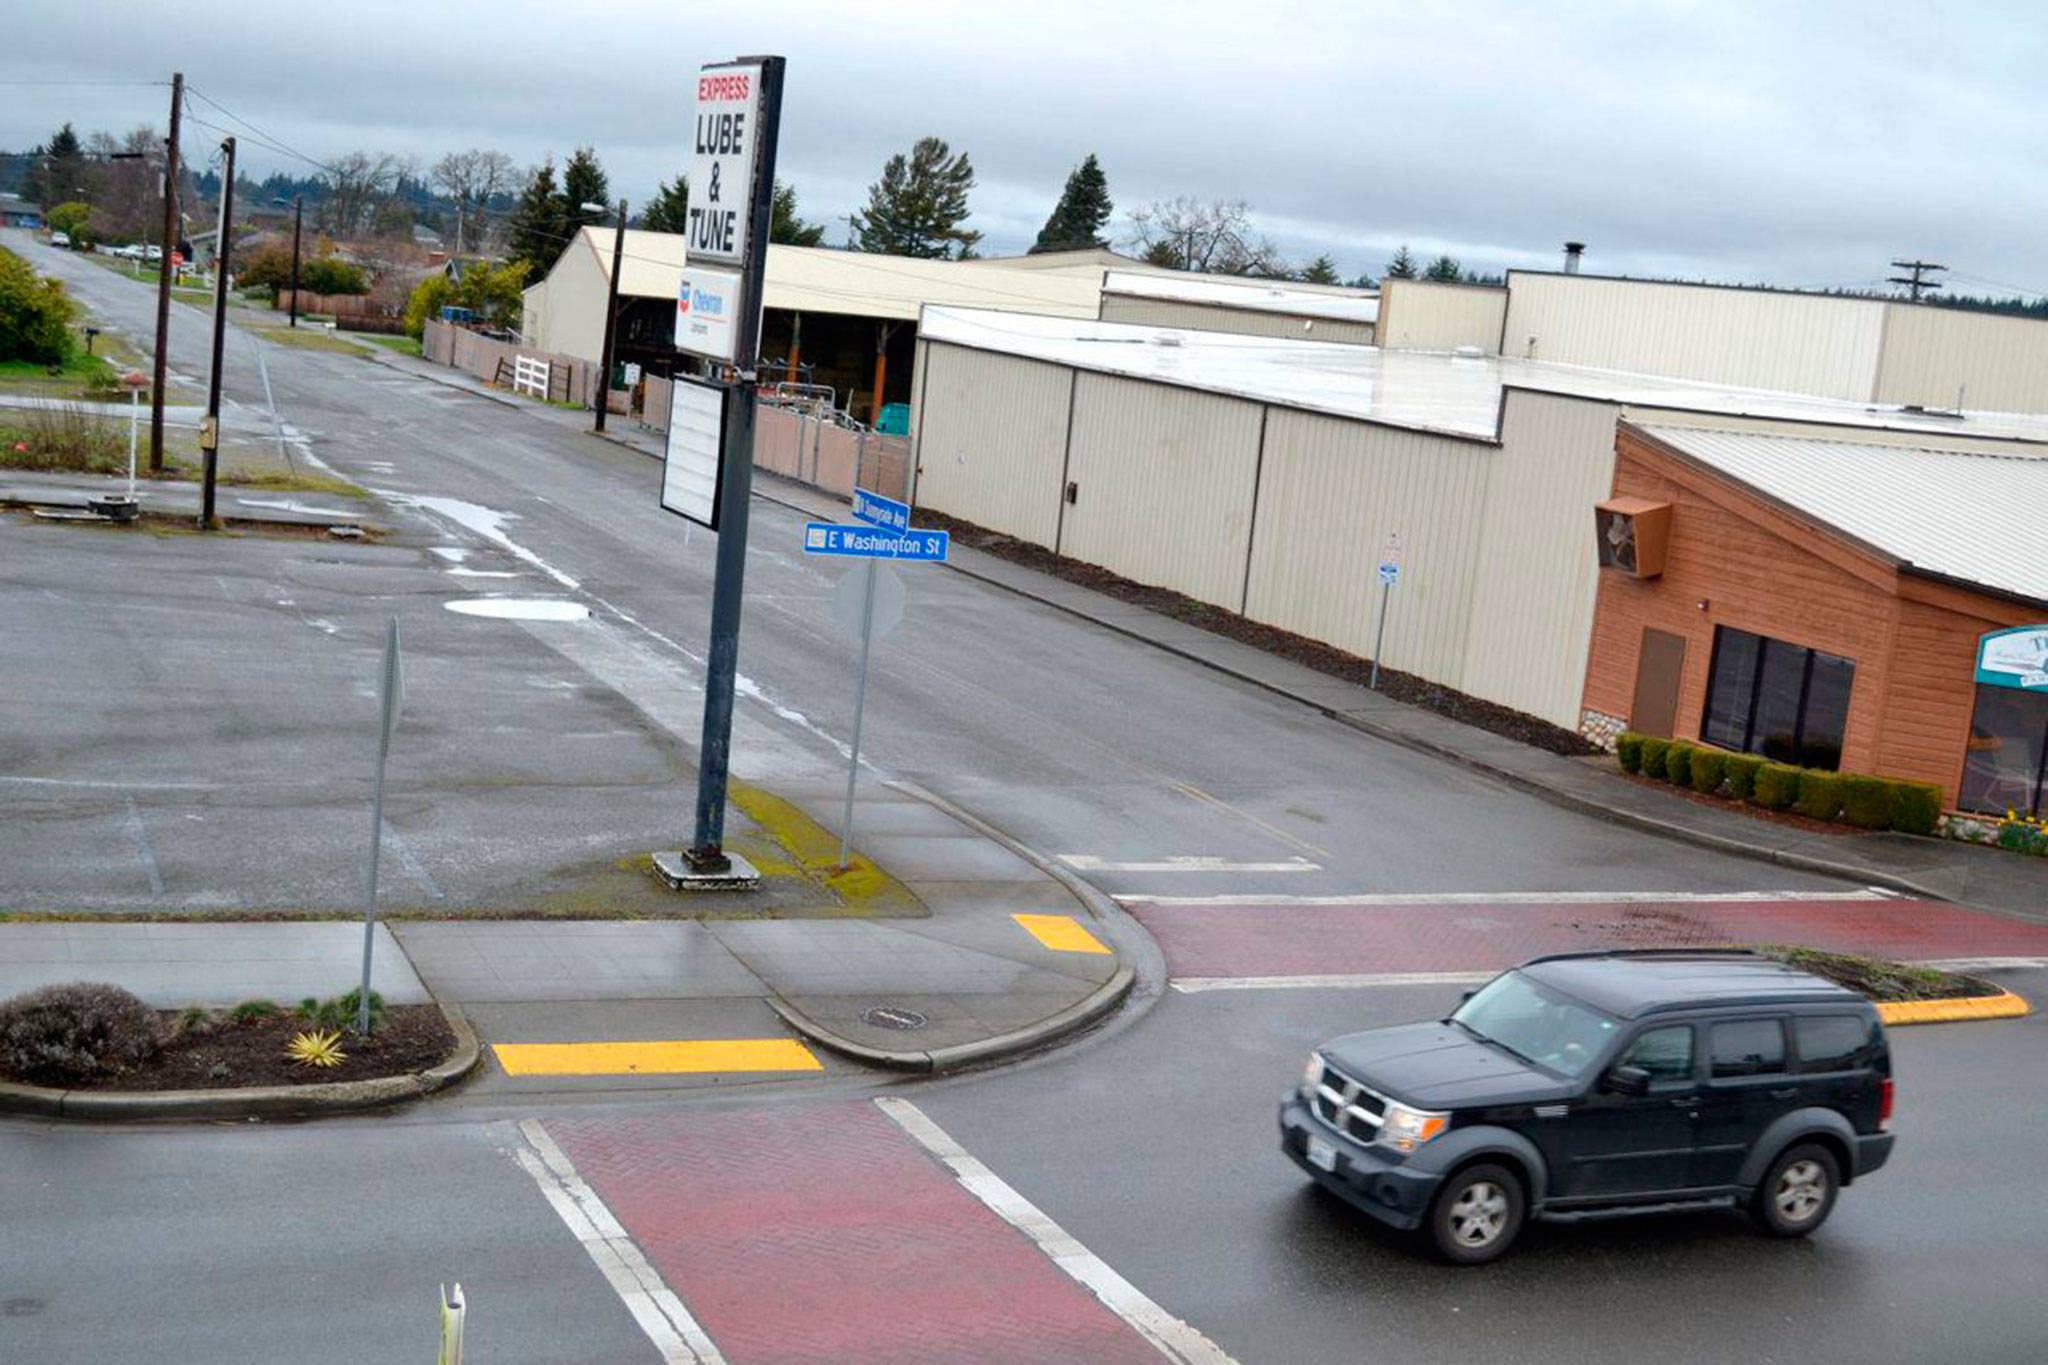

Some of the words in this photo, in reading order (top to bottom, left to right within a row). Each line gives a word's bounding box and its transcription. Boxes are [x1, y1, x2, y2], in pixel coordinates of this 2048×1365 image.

[699, 75, 750, 101] EXPRESS
[696, 113, 745, 154] LUBE
[708, 161, 721, 202] &
[690, 208, 736, 252] TUNE
[829, 531, 838, 548] E
[843, 532, 921, 557] Washington
[926, 537, 940, 554] St
